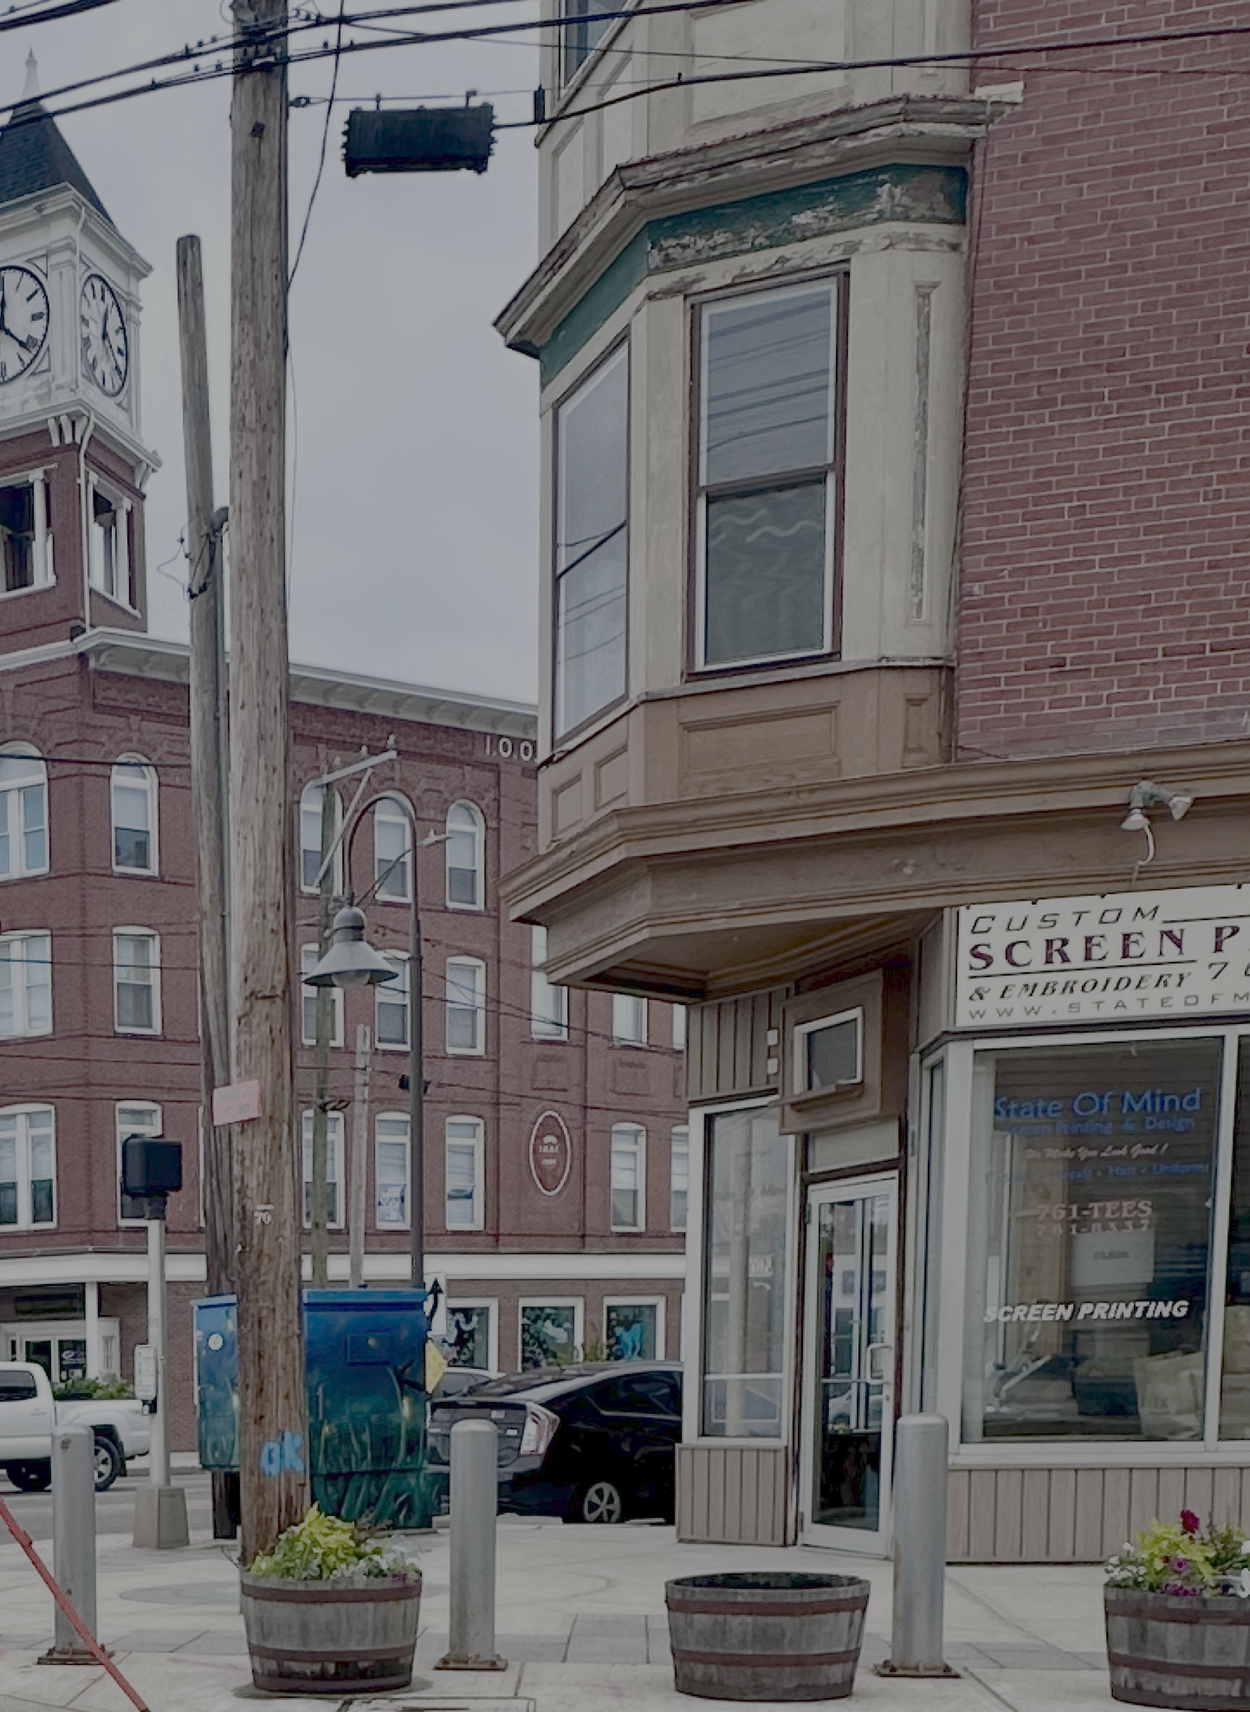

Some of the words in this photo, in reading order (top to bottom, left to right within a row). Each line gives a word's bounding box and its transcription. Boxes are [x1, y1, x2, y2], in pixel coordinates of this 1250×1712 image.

[970, 904, 1159, 934] CUSTOM
[968, 928, 1185, 971] SCREEN
[969, 986, 991, 1002] &
[999, 971, 1193, 1000] EMBROIDERY
[995, 1096, 1064, 1119] State
[1072, 1091, 1114, 1117] Of
[1121, 1087, 1204, 1114] Mind
[253, 1210, 272, 1225] 70
[1036, 1200, 1152, 1221] 761-TEES
[983, 1303, 1074, 1323] SCREEN
[1077, 1300, 1189, 1320] PRINTING
